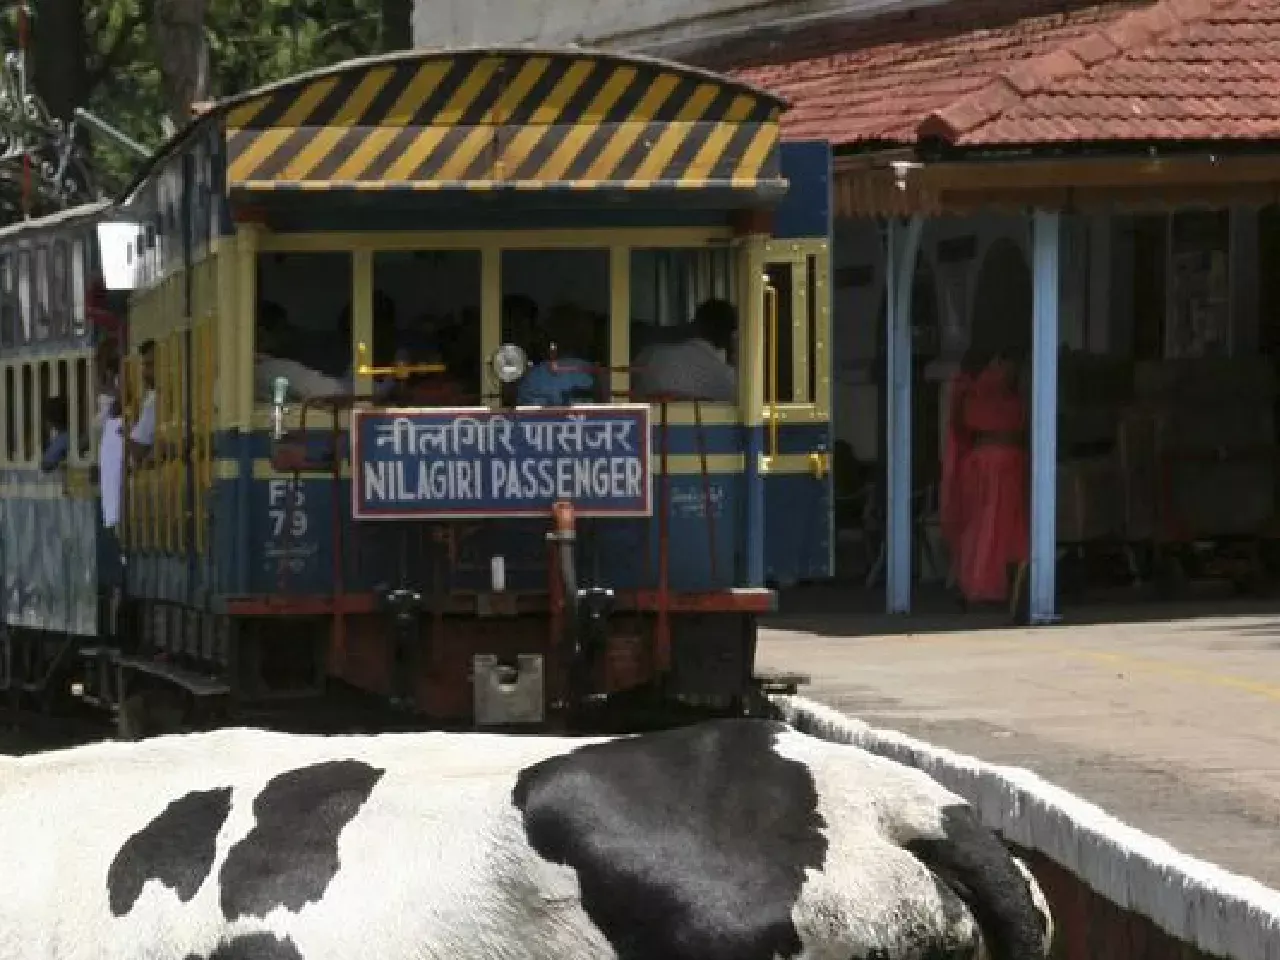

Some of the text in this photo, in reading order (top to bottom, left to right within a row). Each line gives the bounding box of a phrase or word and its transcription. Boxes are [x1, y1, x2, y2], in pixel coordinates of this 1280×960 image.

[364, 460, 483, 500] NILAGIRI
[491, 456, 642, 499] PASSENGER
[268, 509, 309, 537] 79
